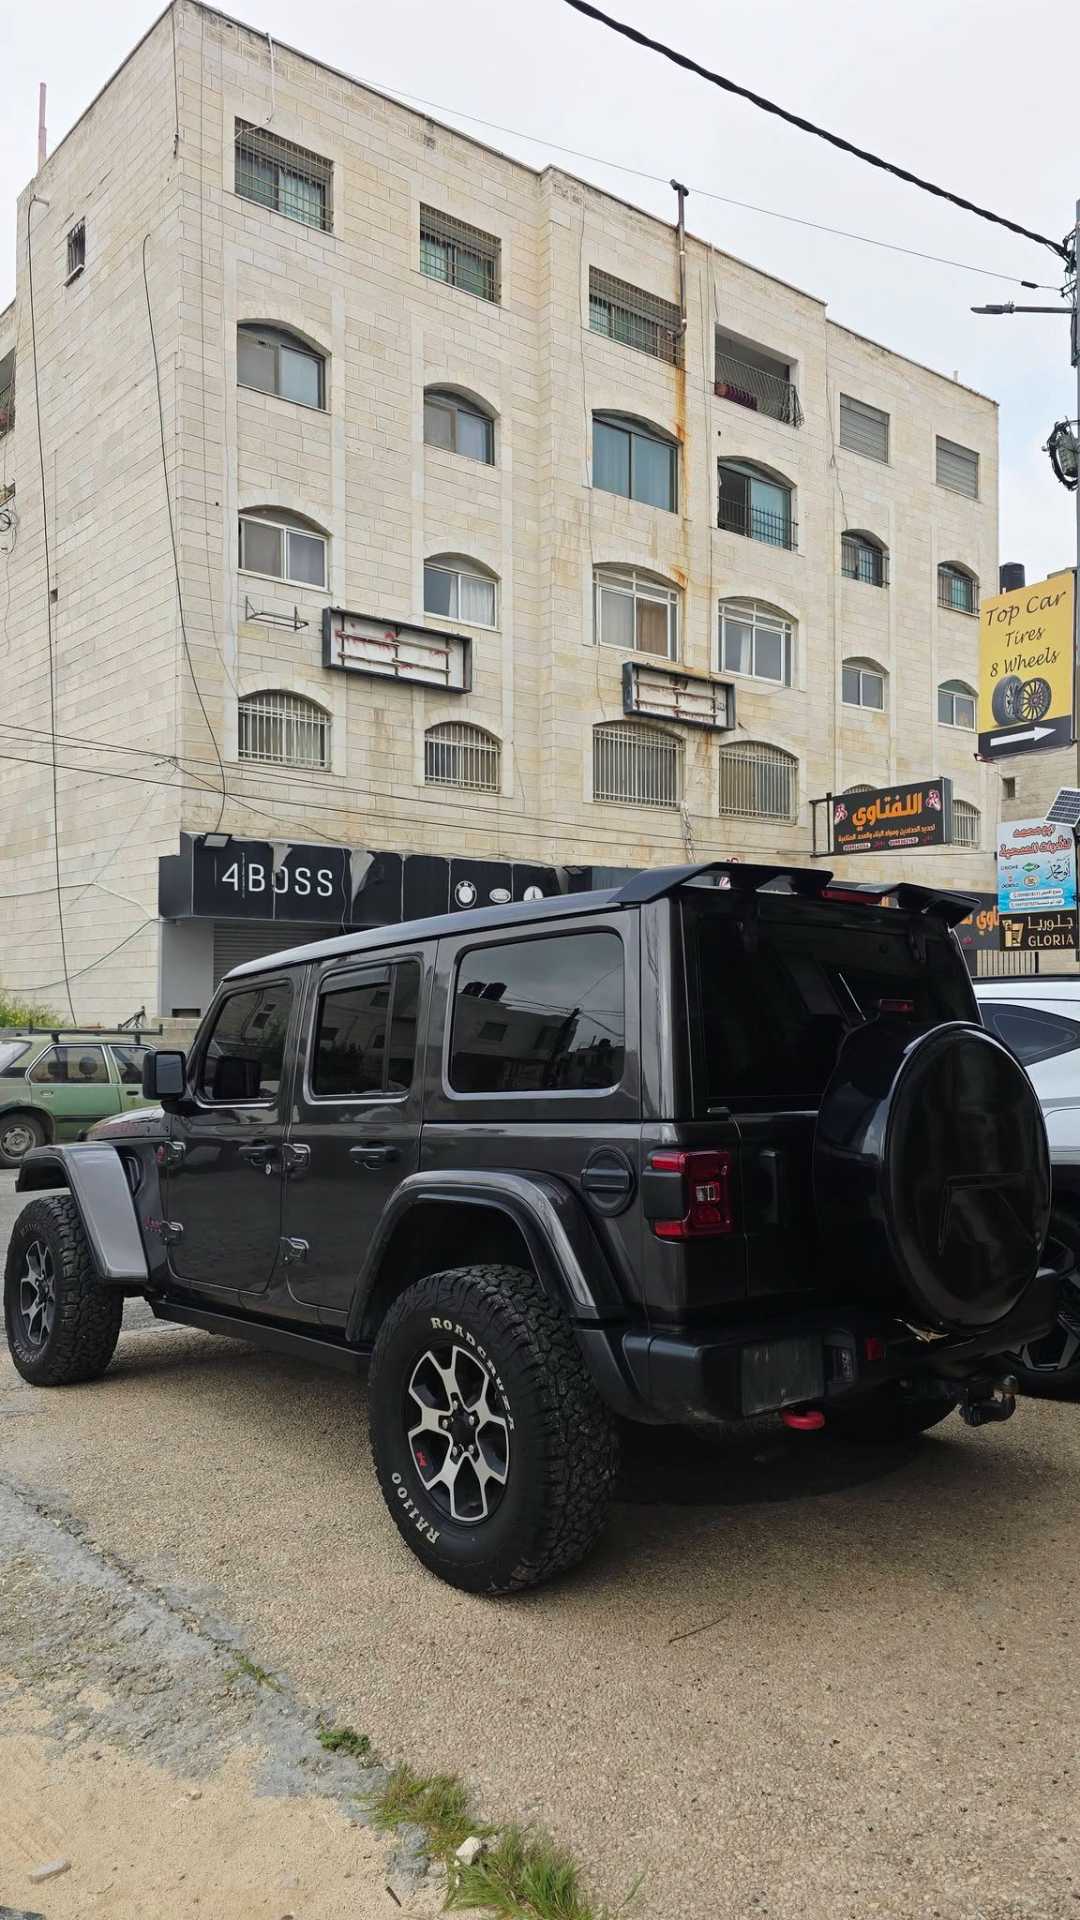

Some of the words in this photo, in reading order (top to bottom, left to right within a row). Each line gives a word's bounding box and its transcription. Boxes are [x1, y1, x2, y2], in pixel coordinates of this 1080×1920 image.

[986, 604, 1020, 626] Top
[1026, 591, 1067, 614] Car
[1005, 627, 1046, 647] Tires
[1004, 646, 1060, 674] Wheels
[1027, 914, 1074, 931] جلوريا
[1028, 934, 1074, 947] GLORIA
